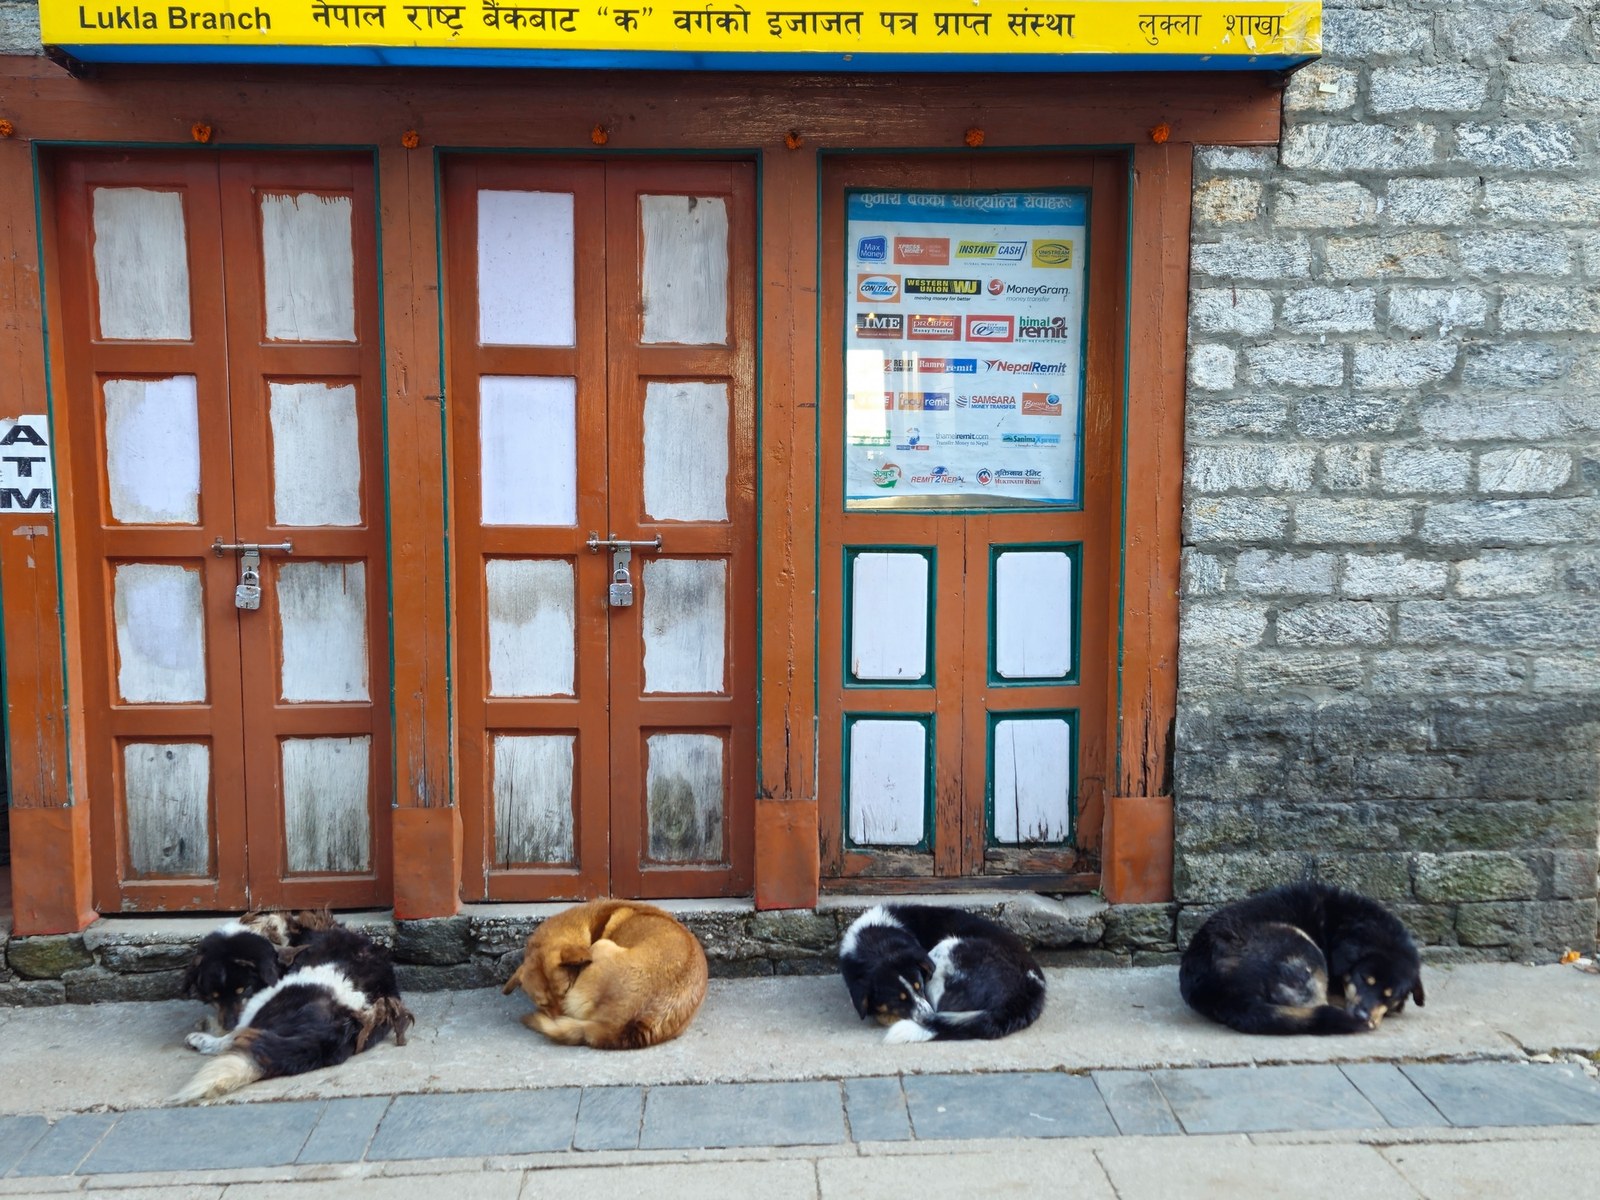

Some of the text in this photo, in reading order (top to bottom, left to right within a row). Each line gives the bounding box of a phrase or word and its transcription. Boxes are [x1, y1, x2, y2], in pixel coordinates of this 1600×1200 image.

[79, 6, 272, 30] Lukla Branch
[312, 0, 386, 28] नेपाल
[482, 0, 579, 32] बैंकबाट
[673, 3, 751, 34] वर्गको
[766, 11, 864, 38] इजाजत
[880, 12, 918, 36] पत्र
[934, 13, 992, 36] प्राप्त
[1007, 7, 1076, 37] संस्था
[1138, 14, 1284, 45] लुक्ला शाखा
[864, 243, 880, 251] Max
[959, 245, 1022, 255] INSTANT CASH
[860, 250, 884, 258] Money
[1006, 284, 1068, 296] MoneyGram
[864, 317, 900, 329] IME
[1019, 315, 1050, 326] himal
[1018, 320, 1068, 338] remit
[919, 360, 945, 368] Ramro
[946, 363, 973, 371] remit
[997, 361, 1067, 374] NepalRemit
[924, 397, 949, 406] remit
[972, 396, 1016, 405] SAMSARA
